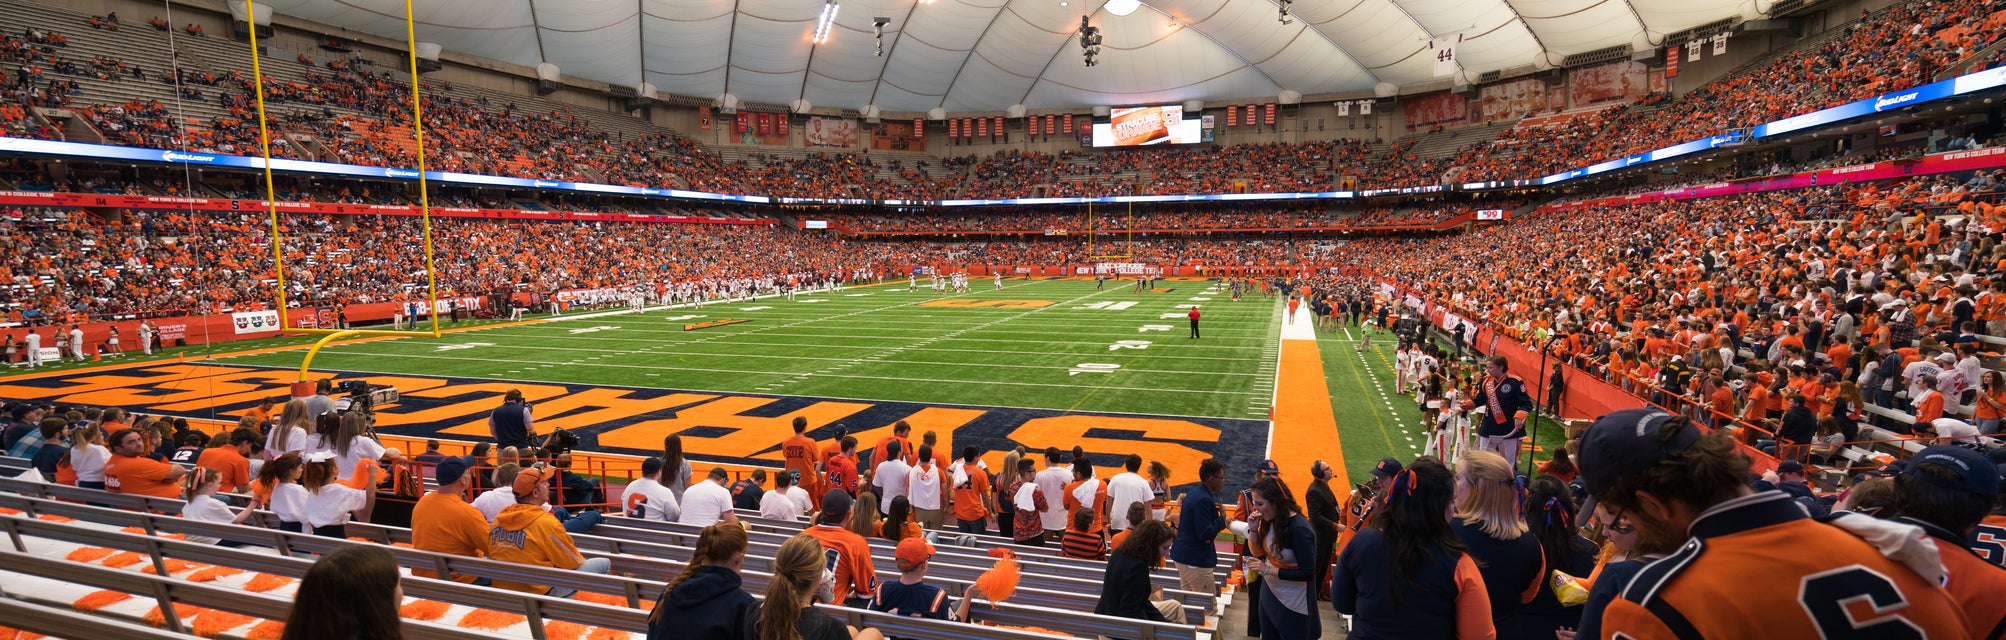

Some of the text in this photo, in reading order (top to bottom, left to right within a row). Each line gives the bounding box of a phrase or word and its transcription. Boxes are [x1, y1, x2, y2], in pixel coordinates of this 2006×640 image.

[1437, 48, 1452, 62] 44
[1115, 113, 1160, 131] SYRACUSE
[172, 450, 193, 461] 12
[829, 470, 842, 486] 44
[627, 493, 648, 518] S
[491, 526, 527, 550] FUBU
